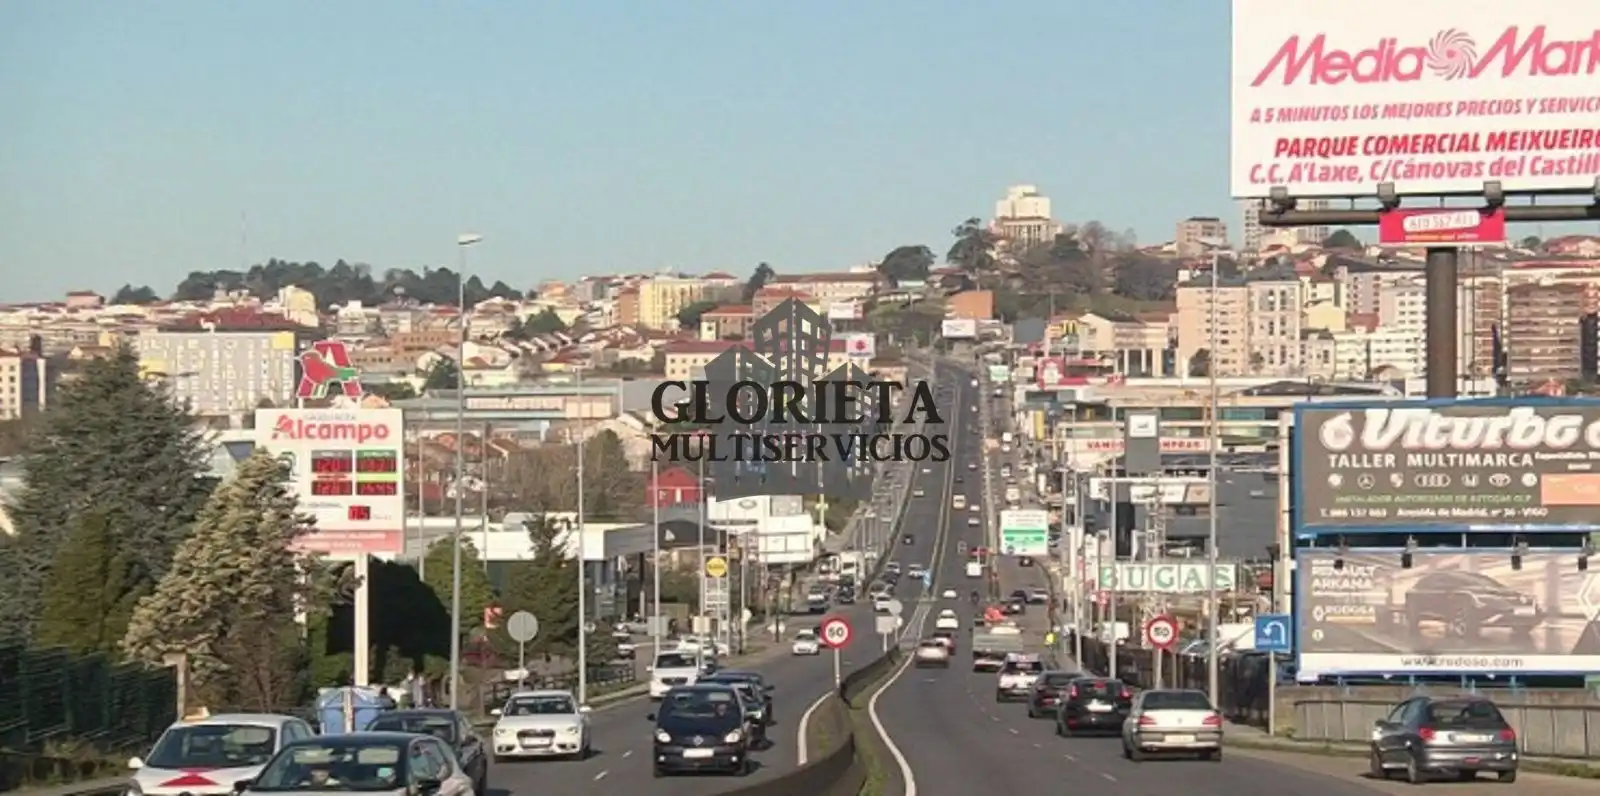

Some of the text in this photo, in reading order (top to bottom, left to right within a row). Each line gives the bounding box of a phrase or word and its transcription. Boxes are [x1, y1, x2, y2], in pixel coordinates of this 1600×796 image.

[1250, 33, 1428, 87] Media
[1250, 108, 1261, 122] A
[1264, 107, 1274, 122] 5
[1276, 105, 1350, 121] MINUTOS
[1352, 104, 1379, 119] LOS
[1381, 102, 1453, 119] MEJORES
[1455, 99, 1522, 116] PRECIOS
[1526, 98, 1538, 114] Y
[1274, 136, 1359, 158] PARQUE
[1362, 131, 1482, 156] COMERCIAL
[1249, 164, 1284, 184] C.C.
[1369, 157, 1485, 182] C/Cánovas
[1489, 155, 1526, 177] del
[271, 415, 390, 443] Alcampo
[1328, 452, 1534, 468] TALLER MULTIMARCA
[1312, 566, 1375, 577] RENAULT
[828, 627, 844, 638] 50
